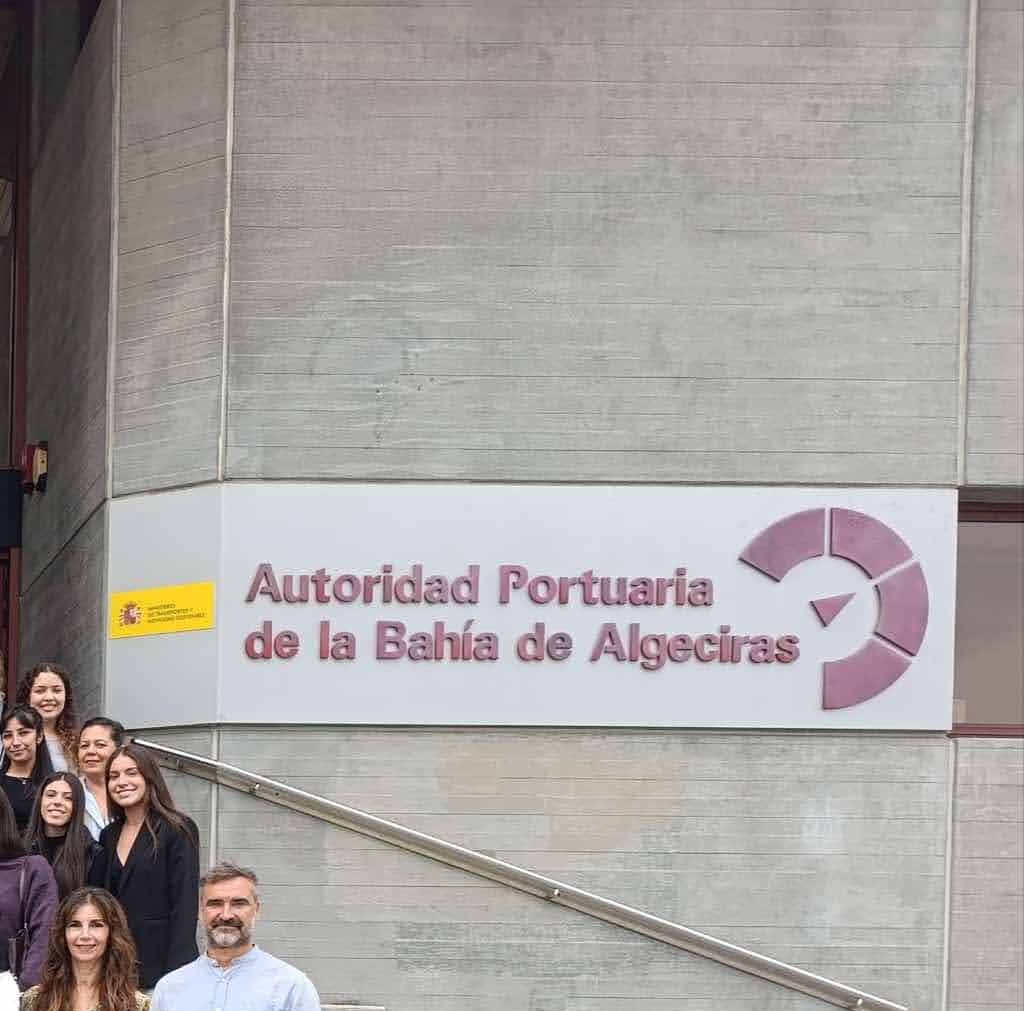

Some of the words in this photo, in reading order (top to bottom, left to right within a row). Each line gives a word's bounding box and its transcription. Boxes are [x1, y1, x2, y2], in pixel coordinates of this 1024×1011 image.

[245, 563, 481, 606] Autoridad
[498, 564, 714, 608] Portuaria
[244, 620, 301, 662] de
[318, 620, 357, 663] la
[375, 618, 500, 663] Bahía
[516, 621, 574, 663] de
[589, 622, 801, 672] Algeciras
